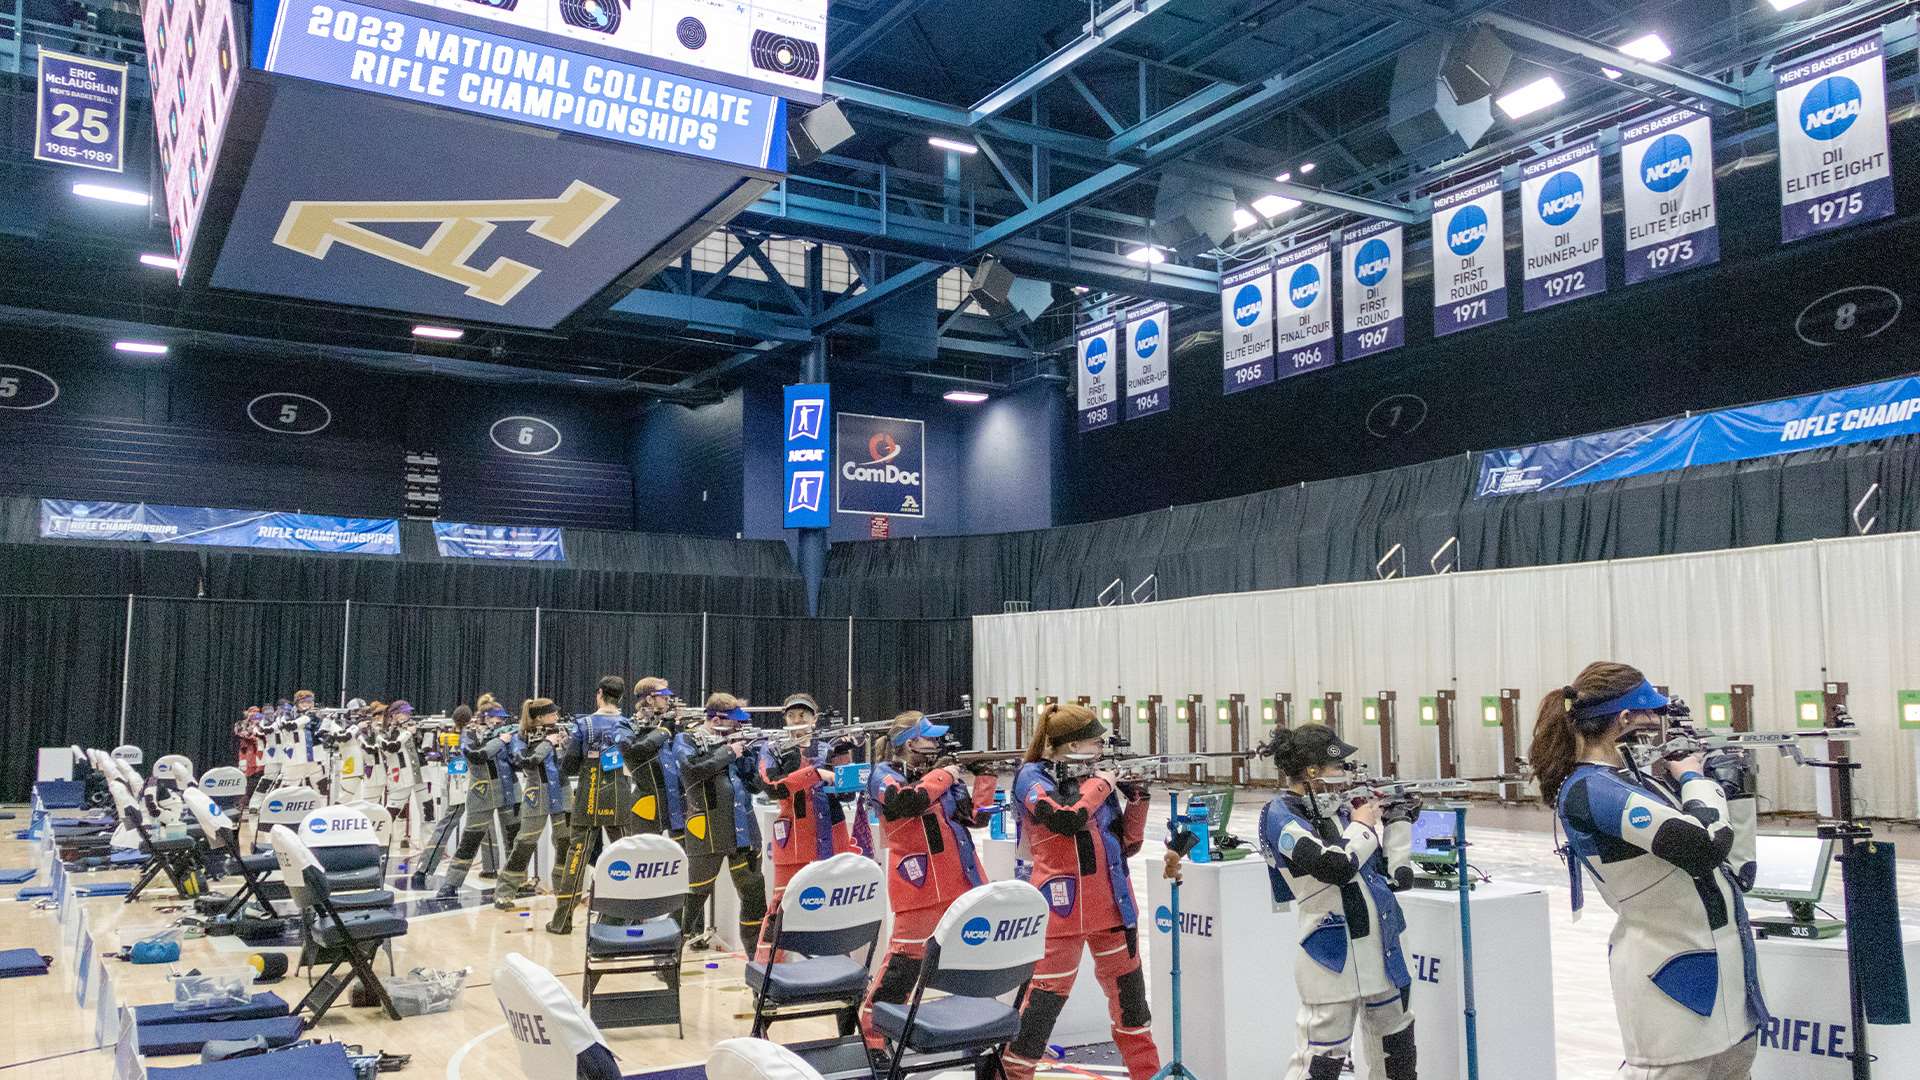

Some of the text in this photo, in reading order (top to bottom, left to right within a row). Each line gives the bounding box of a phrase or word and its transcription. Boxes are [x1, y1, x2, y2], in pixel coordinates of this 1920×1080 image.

[70, 67, 97, 81] ERIC
[307, 5, 754, 127] 2023 NATIONAL COLLEGIATE
[1780, 41, 1879, 84] MEN'S BASKETBALL
[45, 73, 119, 96] McLAUGHLIN
[351, 49, 719, 152] RIFLE CHAMPIONSHIPS
[51, 102, 109, 144] 25
[1806, 98, 1862, 131] NCAA
[1623, 124, 1650, 141] MEN'S
[45, 141, 113, 164] 1985-1989
[1523, 142, 1598, 176] MEN'S BASKETBALL
[1823, 147, 1844, 166] DII
[1645, 155, 1692, 184] NCAA
[1786, 153, 1885, 194] ELITE EIGHT
[1455, 179, 1499, 203] BASKETBALL
[1542, 191, 1584, 218] NCAA
[1659, 199, 1678, 216] DII
[1808, 192, 1864, 225] 1975
[1629, 203, 1711, 241] ELITE EIGHT
[1451, 223, 1488, 248] NCAA
[1554, 232, 1570, 248] DII
[1528, 238, 1600, 270] RUNNER-UP
[1647, 240, 1694, 270] 1973
[1357, 257, 1391, 280] NCAA
[1453, 266, 1485, 286] FIRST
[1450, 279, 1488, 300] ROUND
[1544, 271, 1586, 298] 1972
[1360, 297, 1387, 315] FIRST
[1453, 299, 1487, 323] 1971
[1834, 302, 1858, 331] 8
[1356, 309, 1390, 328] ROUND
[1280, 319, 1331, 346] FINAL FOUR
[1358, 326, 1389, 350] 1967
[1225, 338, 1271, 362] ELITE EIGHT
[1292, 346, 1323, 369] 1966
[1235, 363, 1262, 384] 1965
[0, 376, 19, 398] 5
[279, 403, 298, 423] 5
[1136, 392, 1159, 411] 1964
[1087, 406, 1108, 425] 1958
[1780, 412, 1842, 442] RIFLE
[518, 426, 534, 445] 6
[842, 461, 920, 487] ComDoc
[70, 520, 97, 531] RIFLE
[100, 522, 179, 535] CHAMPIONSHIPS
[259, 525, 394, 545] RIFLE CHAMPIONSHIPS
[217, 778, 241, 788] RIFLE
[285, 799, 316, 812] RIFLE
[598, 808, 615, 817] USA
[332, 818, 369, 832] RIFLE
[634, 859, 682, 880] RIFLE
[829, 881, 879, 908] RIFLE
[992, 913, 1046, 942] RIFLE
[1178, 911, 1213, 938] RIFLE
[508, 1008, 552, 1046] RIFLE
[1759, 1015, 1847, 1059] RIFLE
